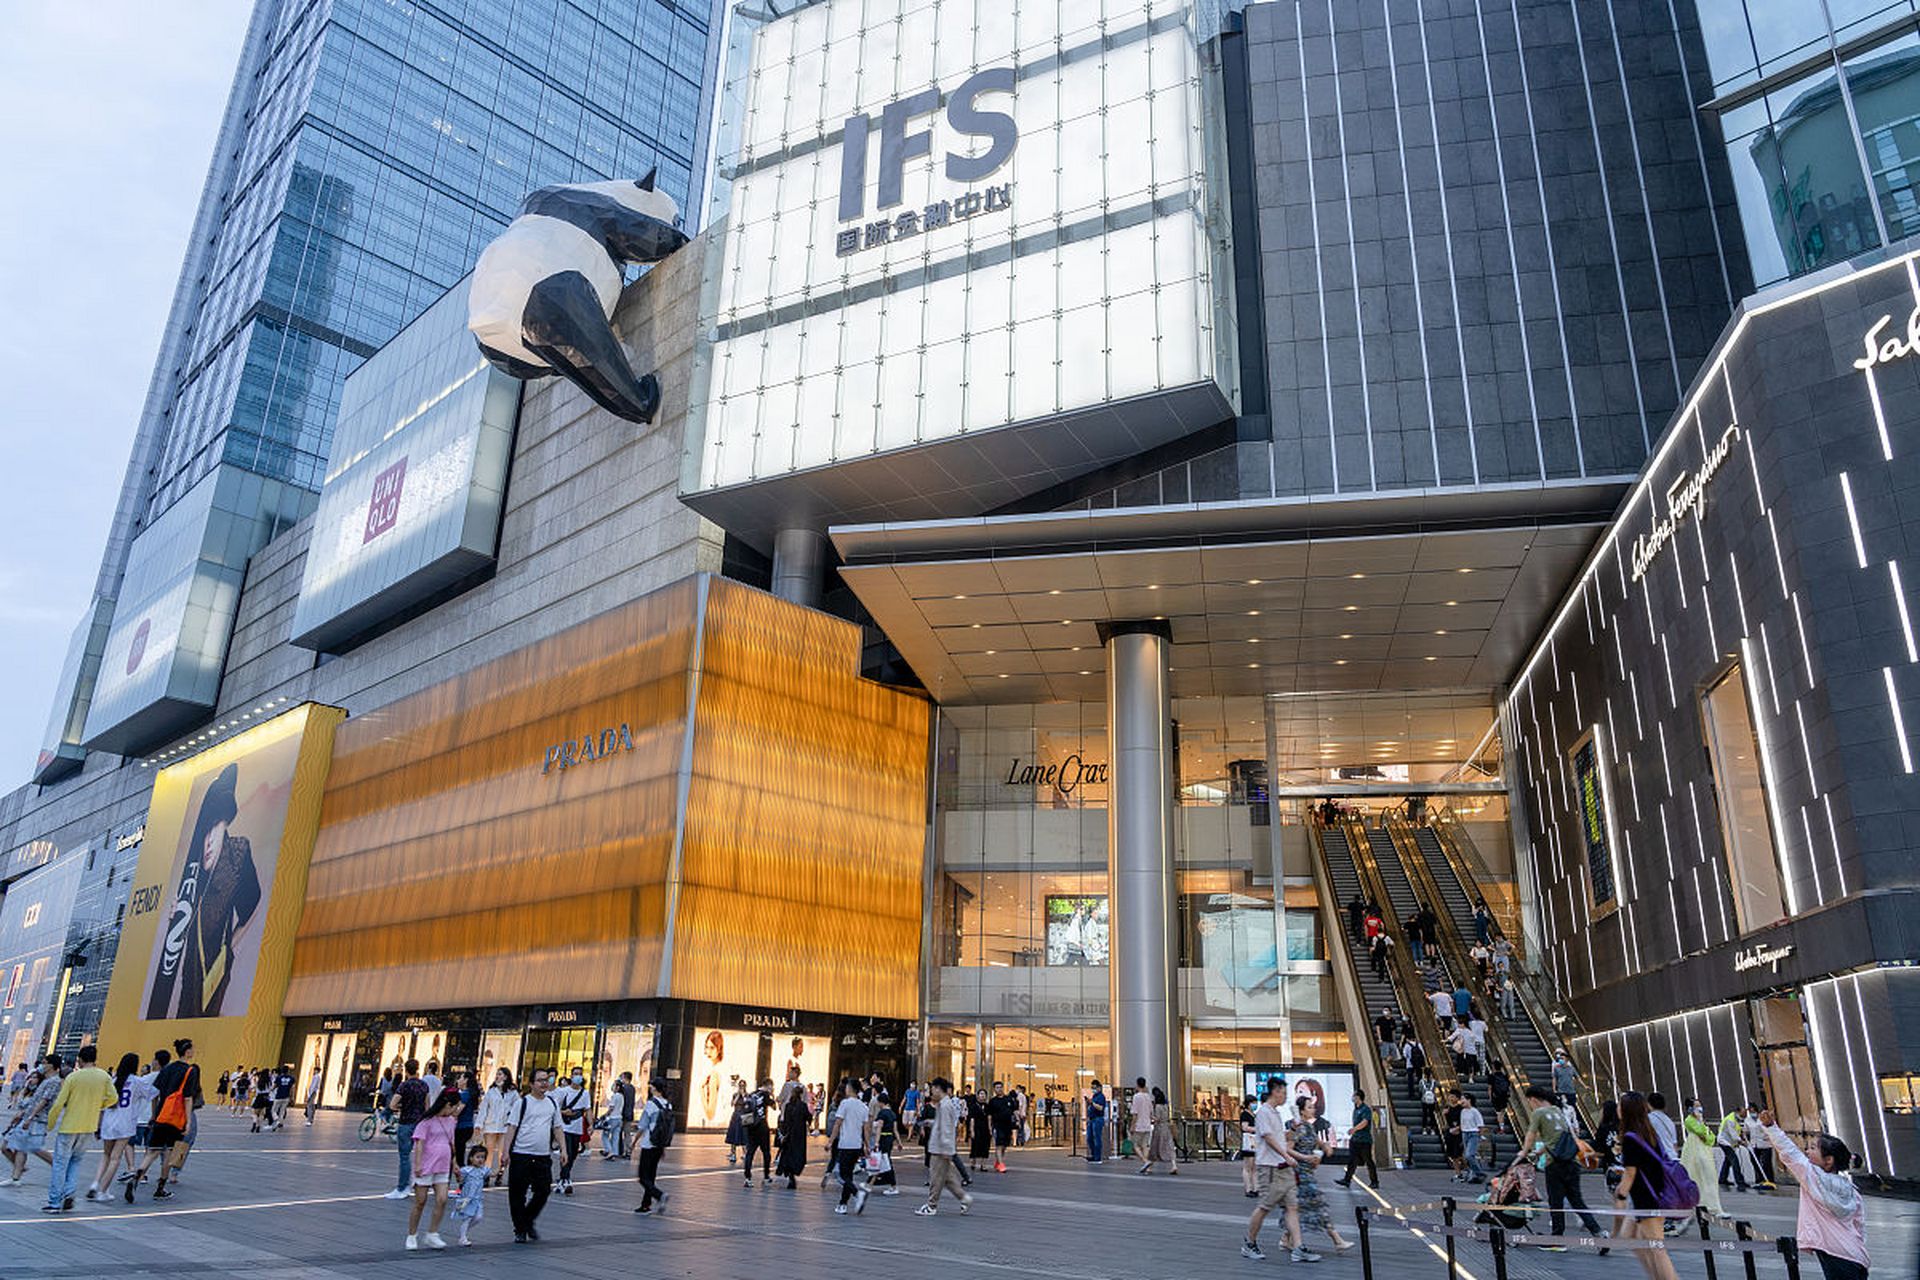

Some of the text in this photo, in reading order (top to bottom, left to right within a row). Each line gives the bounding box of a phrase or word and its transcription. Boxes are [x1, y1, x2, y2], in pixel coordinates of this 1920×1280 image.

[838, 67, 1019, 224] IFS
[836, 182, 1012, 258] 国际金融中心
[374, 469, 401, 503] UNI
[368, 497, 397, 535] QLO
[543, 723, 633, 774] PRADA
[1005, 758, 1057, 785] Lane
[130, 884, 163, 917] FENDI
[743, 1013, 790, 1028] PRADA
[1001, 993, 1032, 1014] IFS
